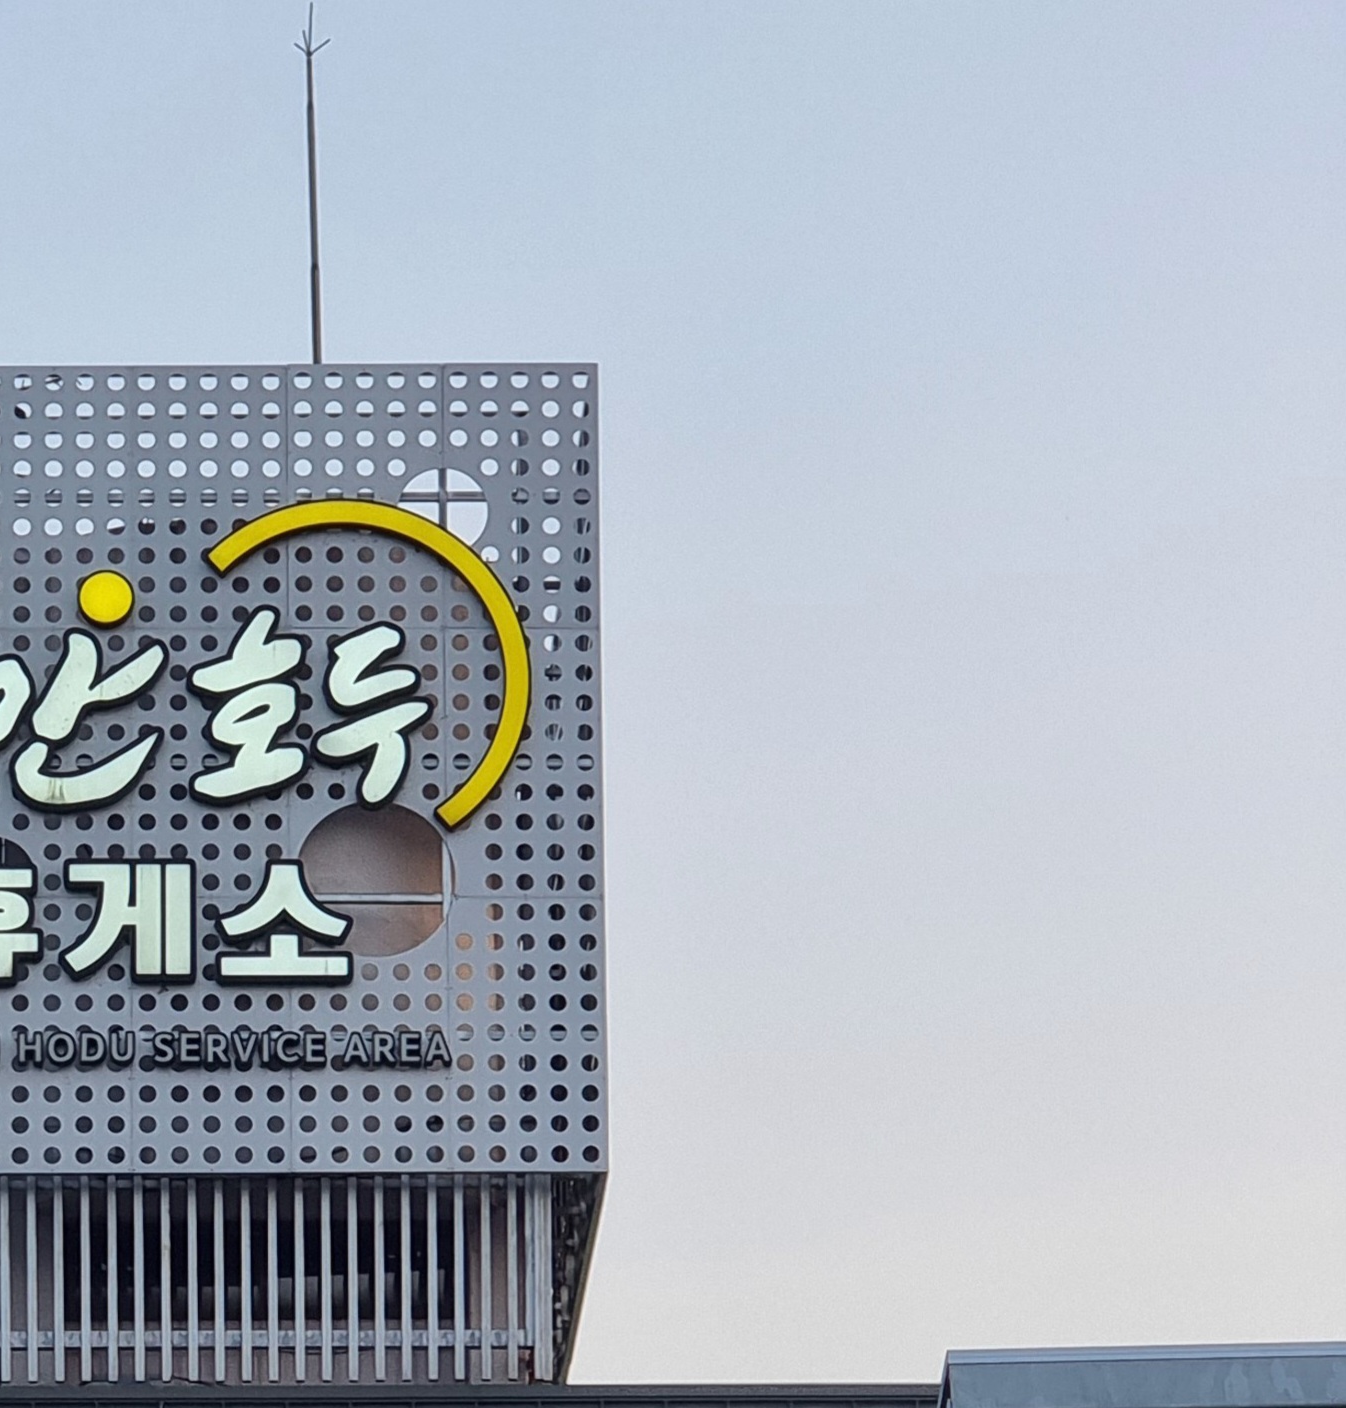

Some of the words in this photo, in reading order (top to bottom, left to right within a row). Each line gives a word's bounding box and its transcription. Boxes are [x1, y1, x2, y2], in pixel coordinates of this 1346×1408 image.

[16, 1030, 137, 1068] HODU
[153, 1030, 327, 1067] SERVICE
[343, 1030, 453, 1067] AREA
